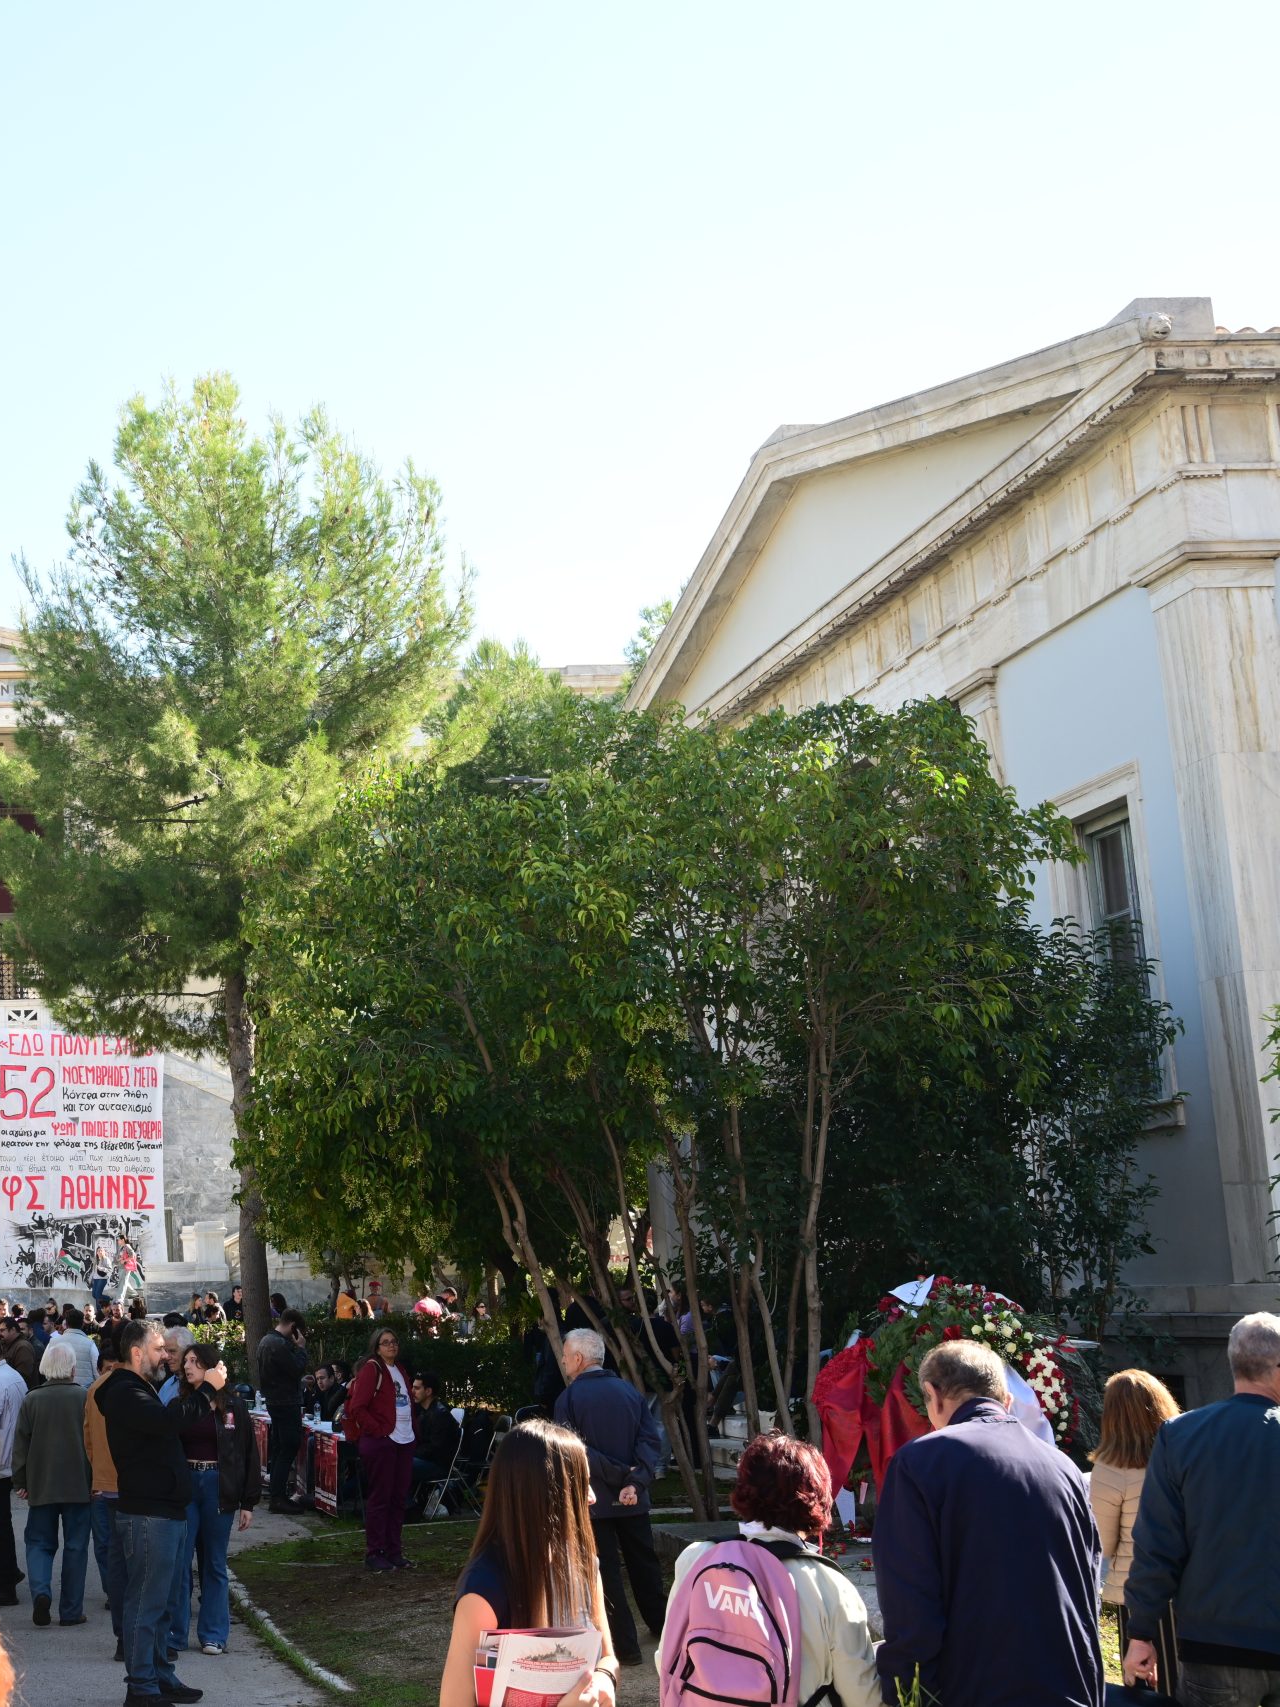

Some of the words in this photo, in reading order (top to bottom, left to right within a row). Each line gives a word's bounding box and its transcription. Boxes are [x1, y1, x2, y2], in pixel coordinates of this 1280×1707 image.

[62, 1065, 130, 1088] ΝΟΕΜΒΡΗΔΕΣ
[134, 1066, 158, 1088] ΜΕΤΑ
[0, 1064, 57, 1121] 52
[62, 1086, 98, 1100] Κόντρα
[100, 1090, 121, 1099] στην
[123, 1088, 149, 1100] λήθη
[63, 1102, 76, 1112] και
[79, 1103, 96, 1112] τον
[81, 1121, 119, 1138] ΠΑΙΔΕΙΑ
[122, 1120, 162, 1139] ΕΛΕΥΘΕΡΙΑ
[35, 1140, 50, 1149] την
[60, 1174, 156, 1211] ΑΘΗΝΑΣ
